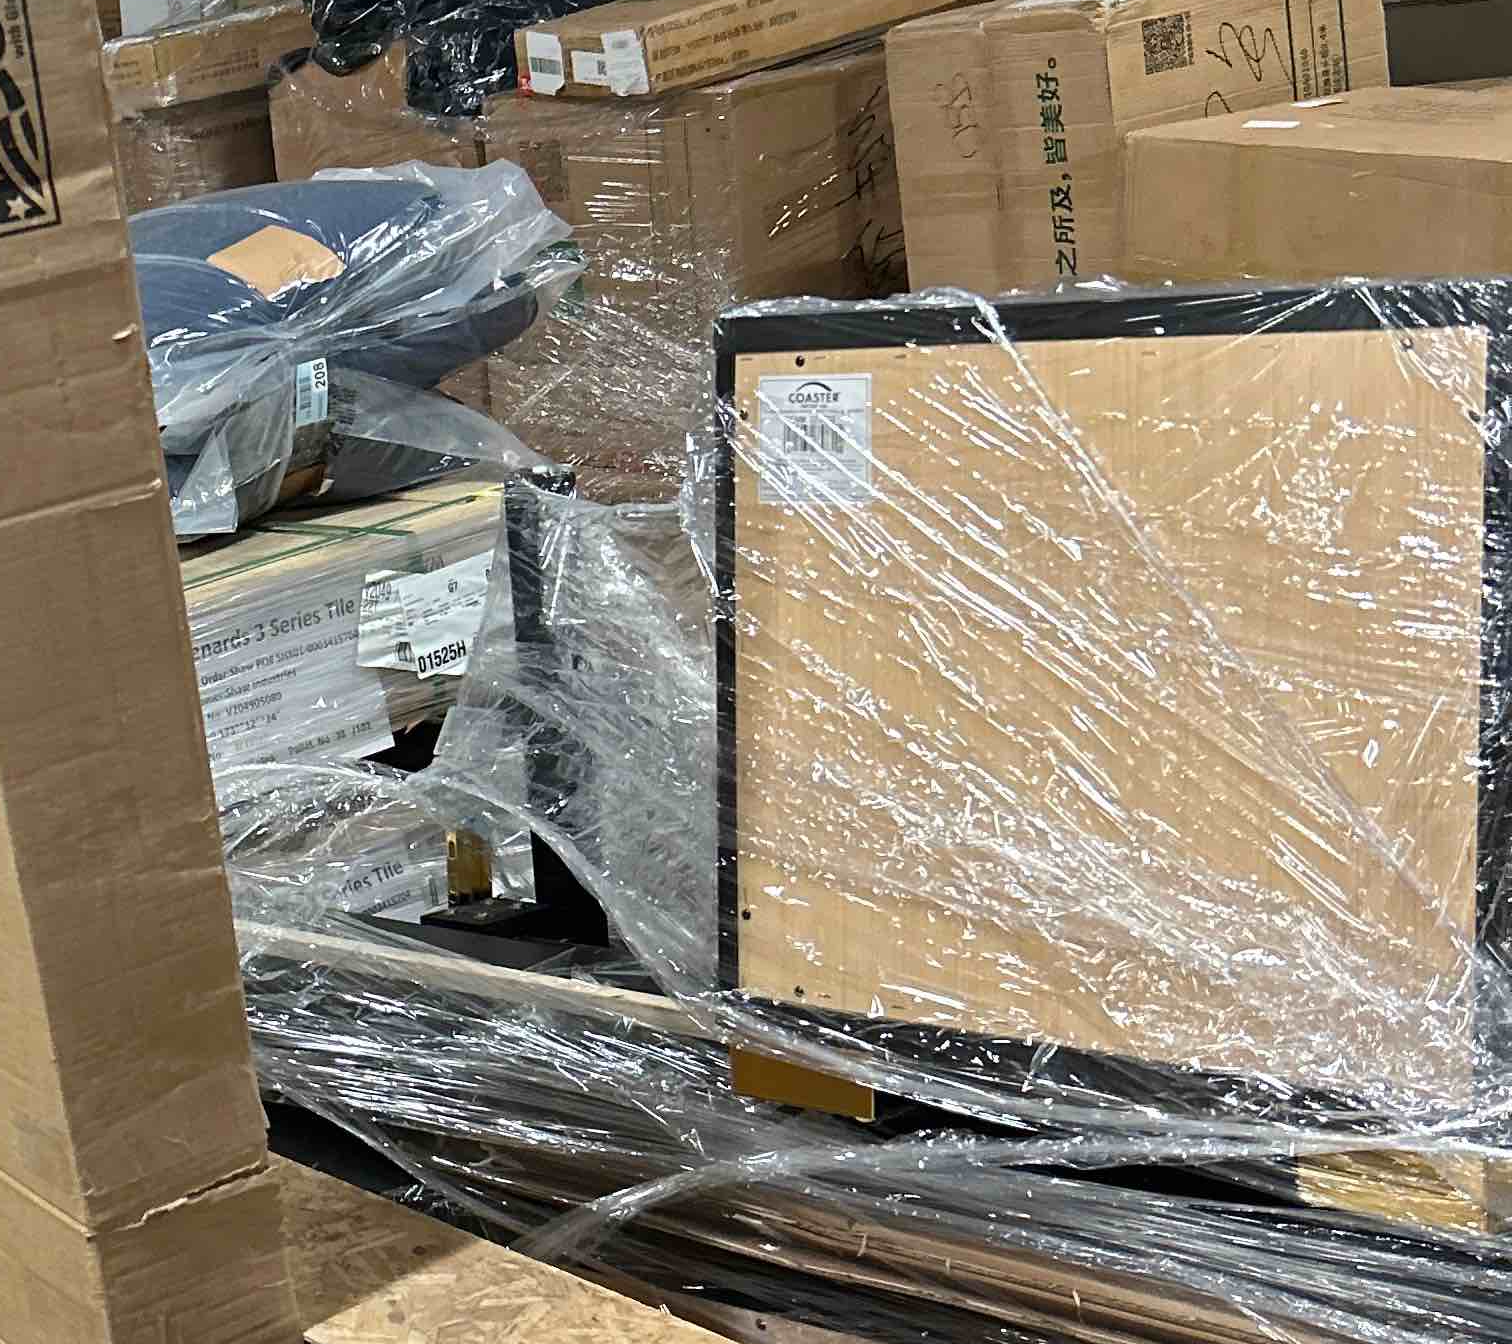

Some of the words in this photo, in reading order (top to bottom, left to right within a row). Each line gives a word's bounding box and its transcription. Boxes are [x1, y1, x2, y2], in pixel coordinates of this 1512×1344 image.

[313, 362, 326, 389] 208
[193, 629, 250, 662] enards
[271, 611, 321, 637] Series
[325, 597, 355, 619] Tile
[418, 641, 466, 673] 01525H
